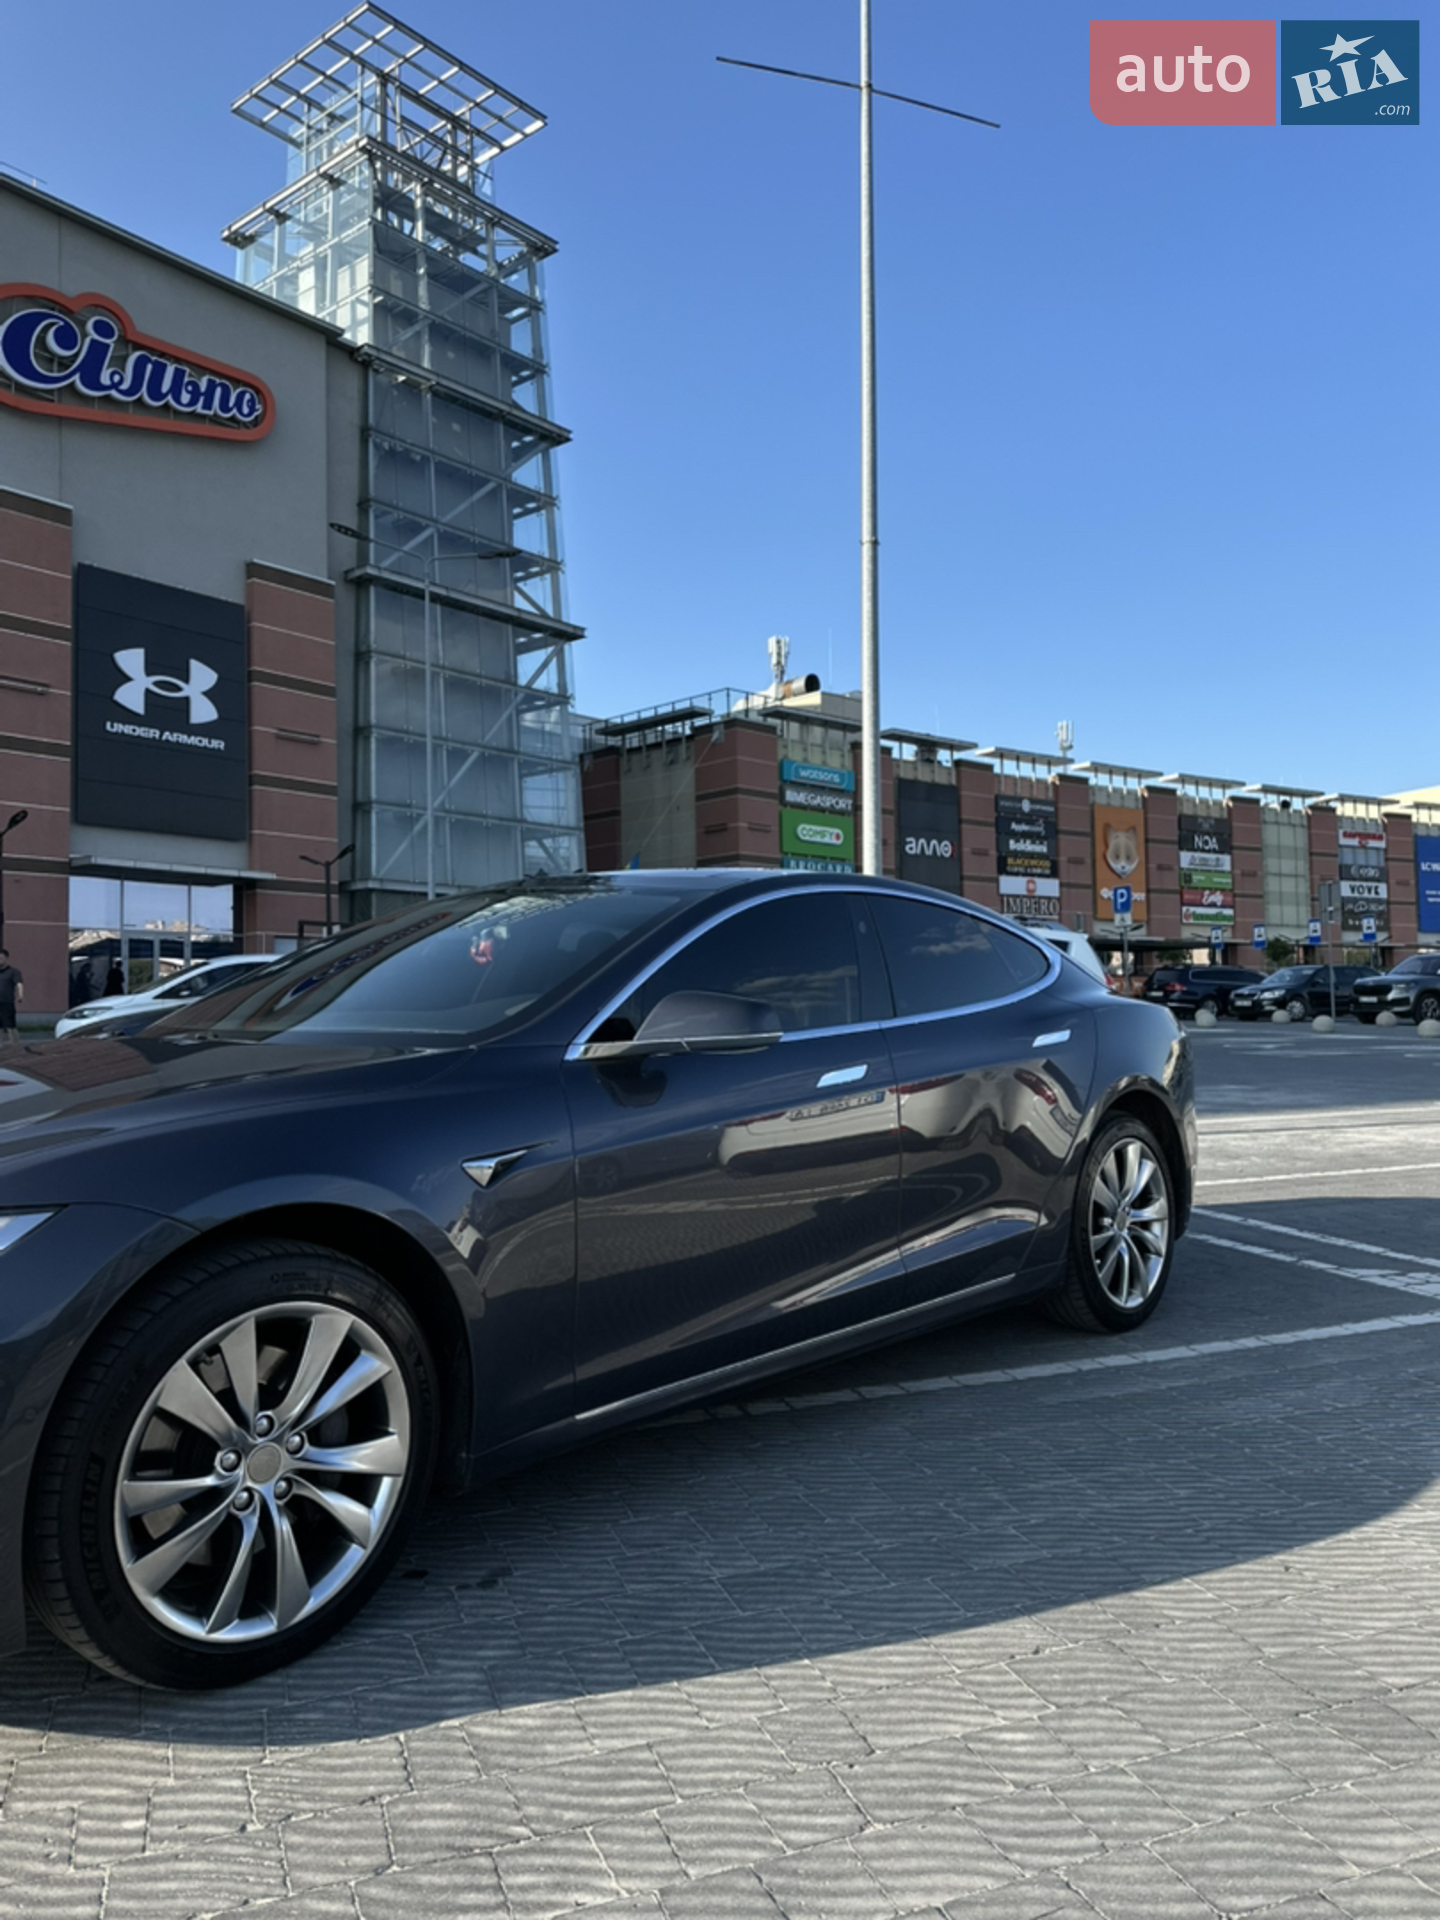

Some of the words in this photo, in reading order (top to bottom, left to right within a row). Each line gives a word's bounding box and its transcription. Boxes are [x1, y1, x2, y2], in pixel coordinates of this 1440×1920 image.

[0, 308, 262, 422] Сільпо
[105, 720, 161, 741] UNDER
[161, 730, 226, 751] ARMOUR
[798, 767, 840, 783] watsons
[800, 826, 834, 841] COMFY
[1002, 896, 1061, 916] IMPERO
[1116, 888, 1128, 911] P
[80, 1460, 106, 1591] MICHELIN
